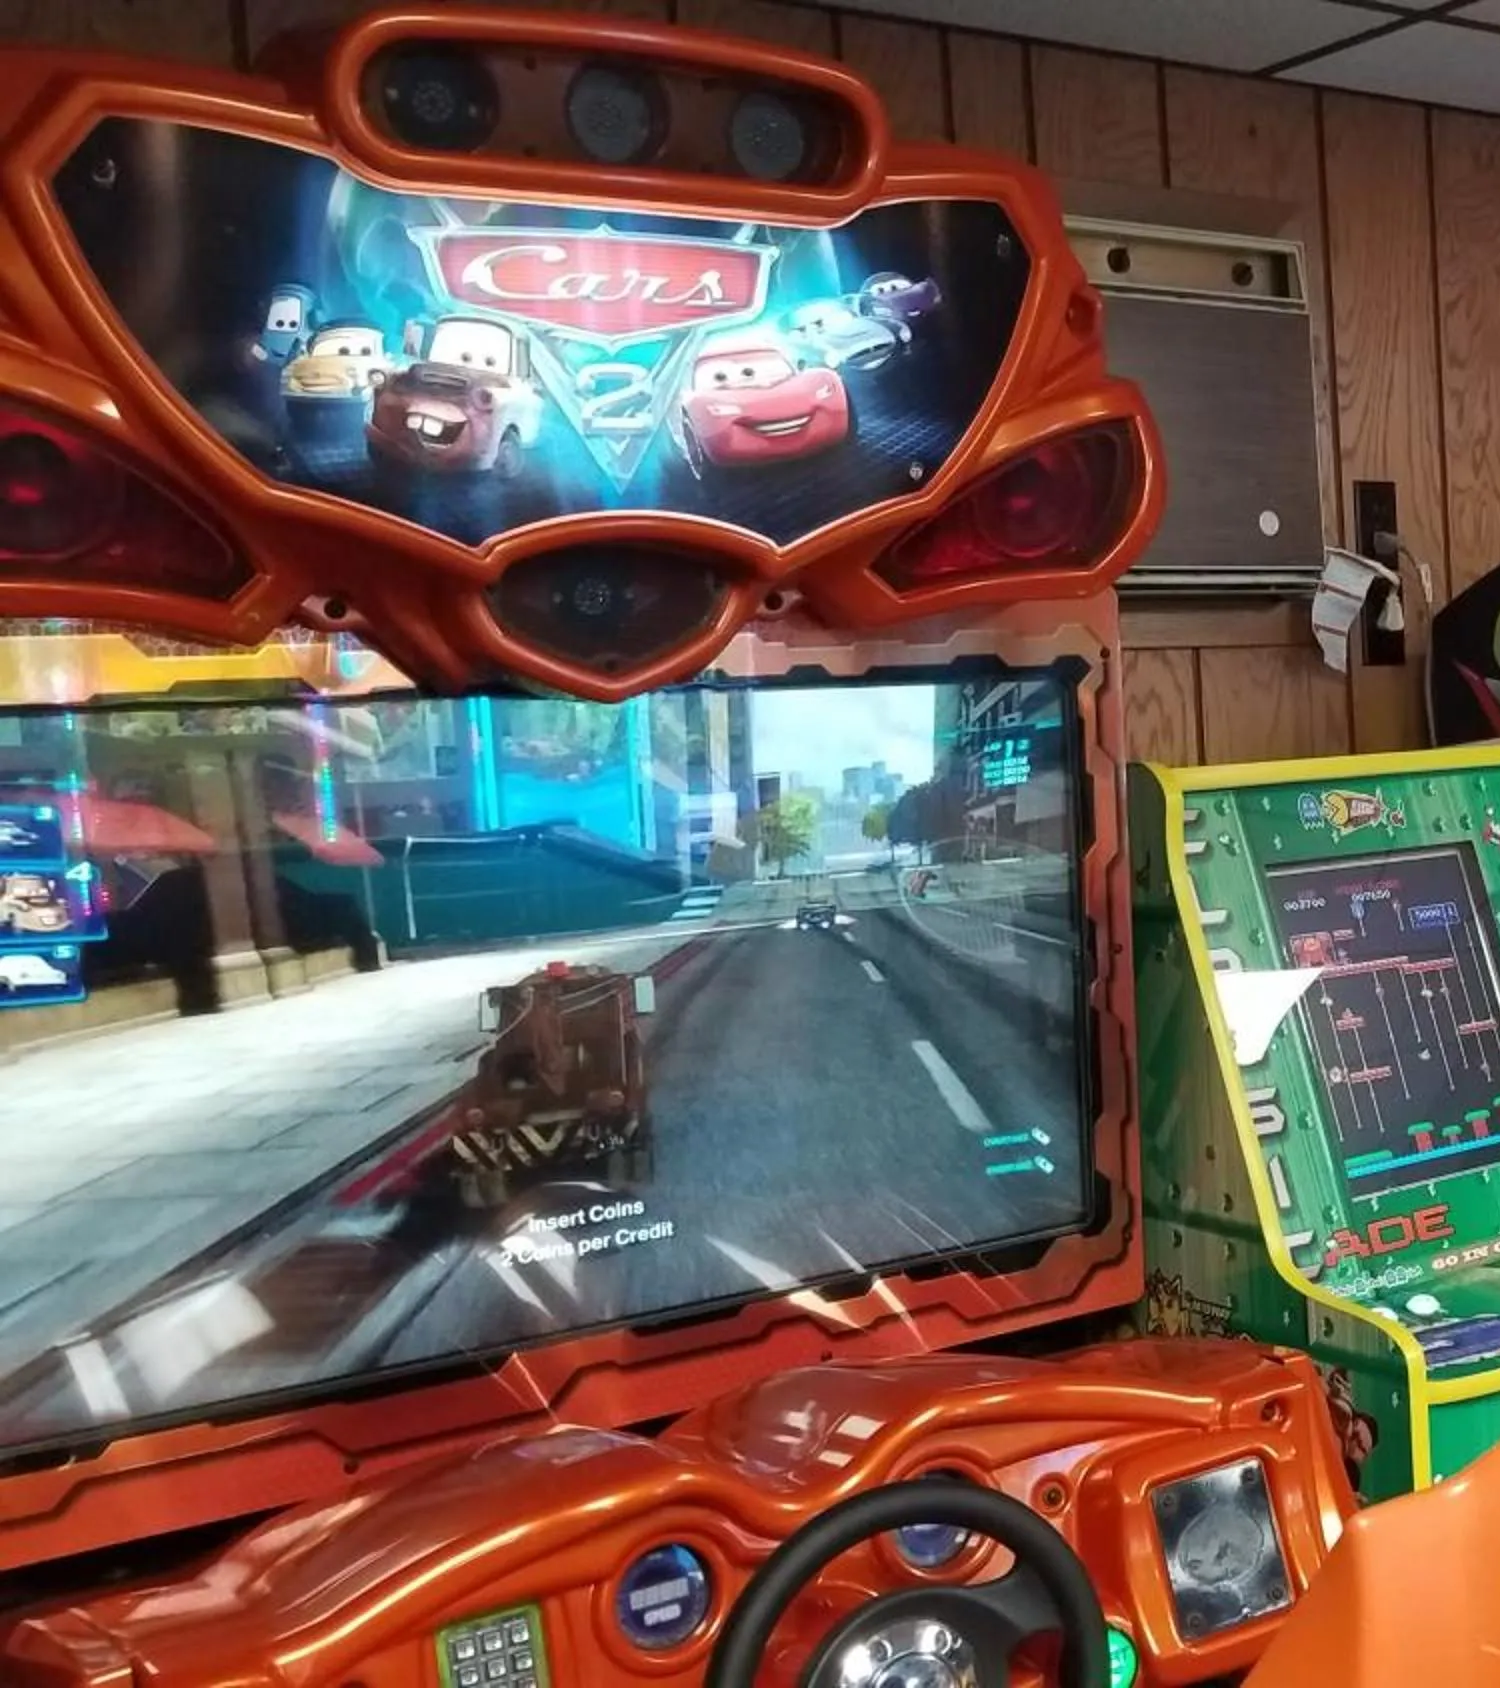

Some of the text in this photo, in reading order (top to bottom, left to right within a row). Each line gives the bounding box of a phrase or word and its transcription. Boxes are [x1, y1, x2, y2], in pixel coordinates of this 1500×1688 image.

[461, 243, 737, 306] Cars
[576, 362, 655, 436] 2
[528, 1200, 646, 1233] Insert Coins
[577, 1235, 612, 1257] per
[615, 1221, 675, 1247] Credit
[1461, 1246, 1489, 1263] IN
